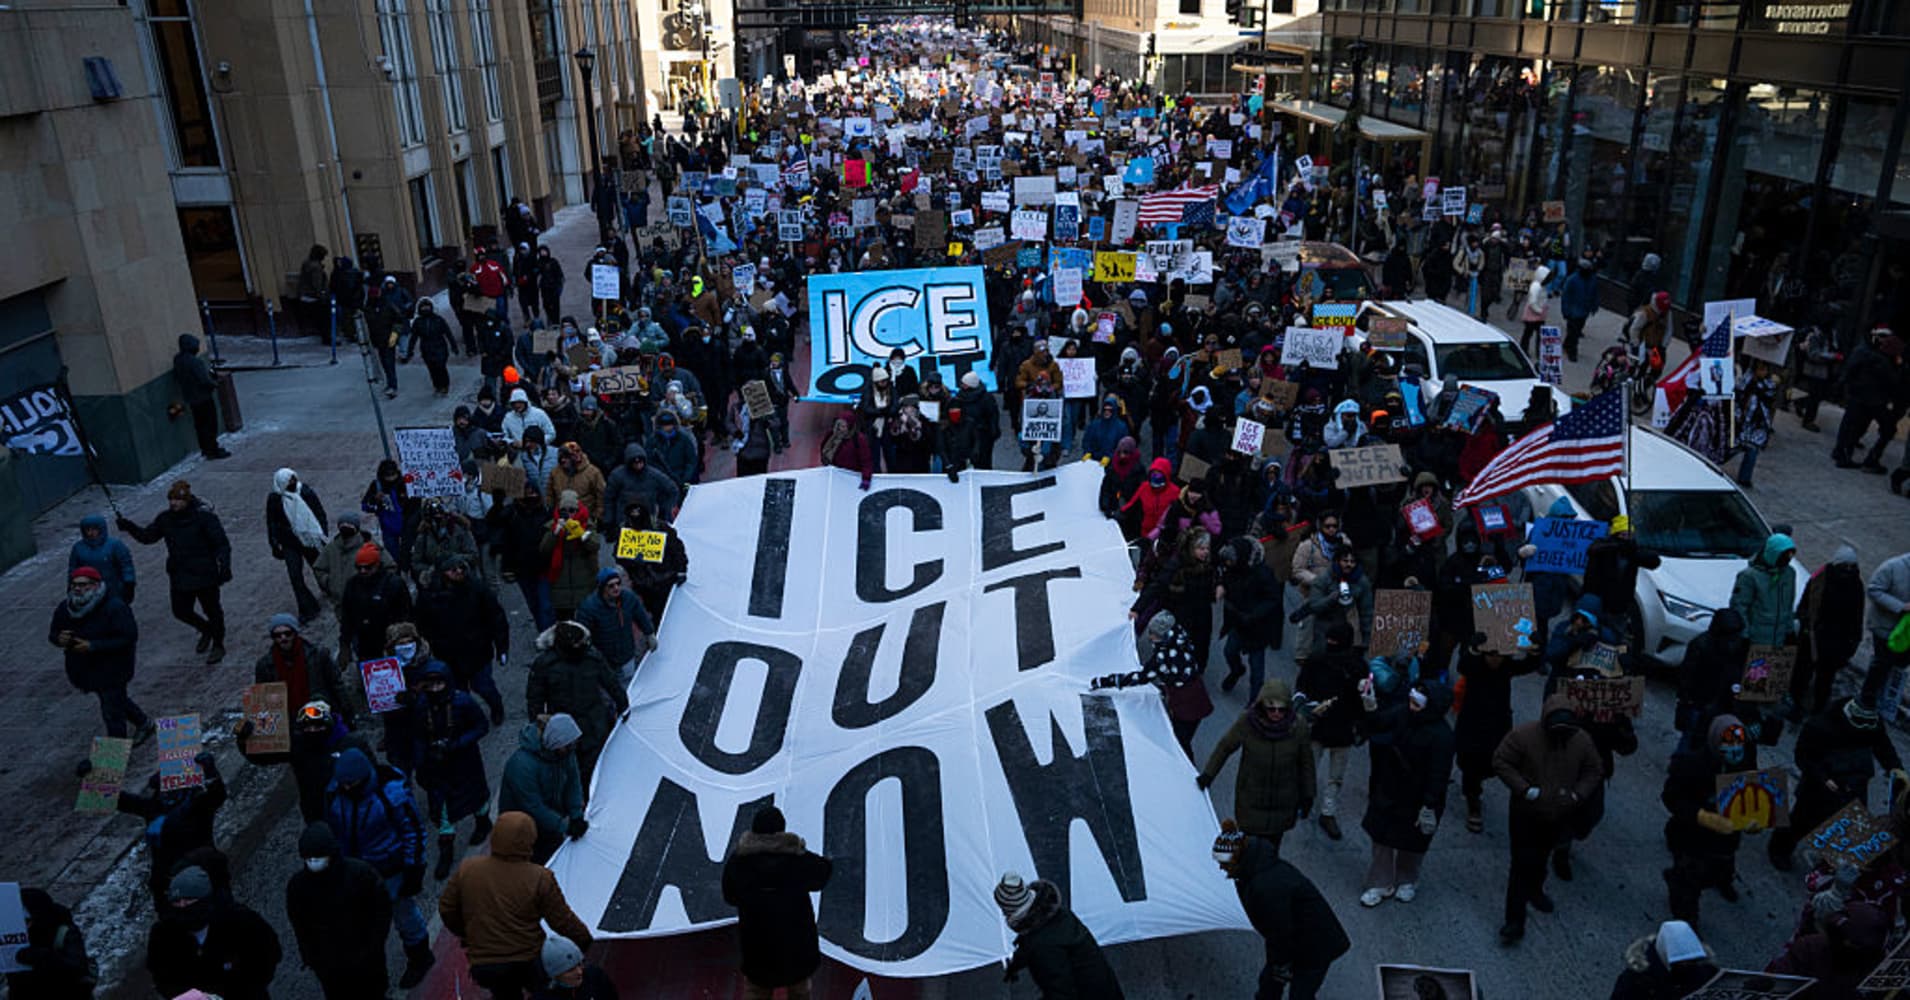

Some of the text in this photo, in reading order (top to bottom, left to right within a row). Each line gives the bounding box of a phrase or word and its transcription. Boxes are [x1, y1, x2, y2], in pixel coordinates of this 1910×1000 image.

[822, 282, 981, 366] ICE
[815, 350, 987, 395] OT
[1338, 447, 1389, 465] ICE
[748, 475, 1066, 619] ICE
[1543, 520, 1599, 540] JUSTICE
[679, 566, 1082, 775] OUT
[597, 694, 1147, 962] NOW
